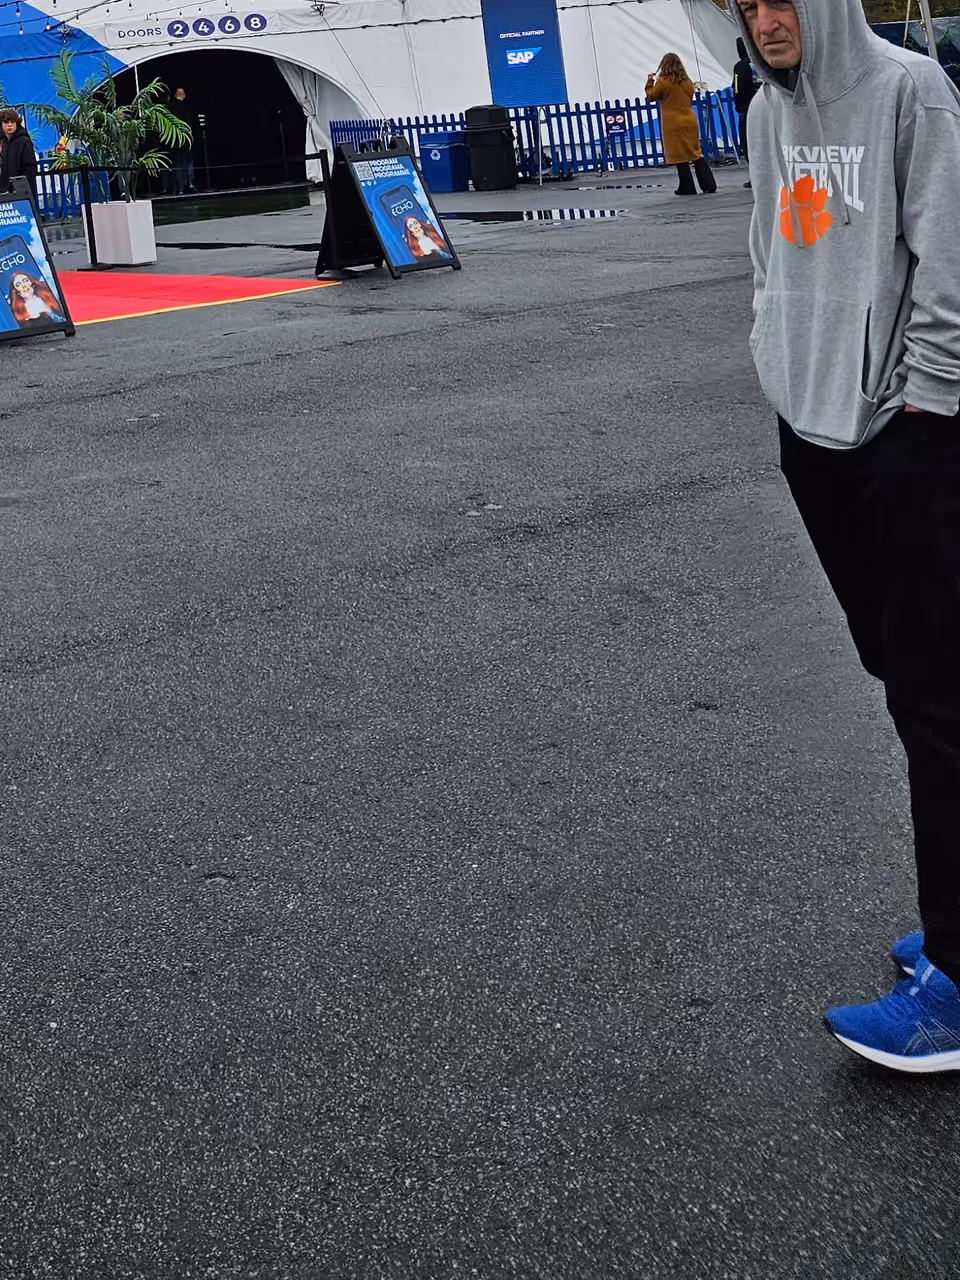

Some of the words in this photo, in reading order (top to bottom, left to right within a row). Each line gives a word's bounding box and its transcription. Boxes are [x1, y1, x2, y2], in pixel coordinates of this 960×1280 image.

[118, 27, 162, 39] DOORS
[173, 23, 185, 36] 2
[198, 21, 210, 33] 4
[224, 19, 235, 32] 6
[250, 17, 261, 29] 8
[522, 29, 545, 37] PARTNER
[506, 50, 534, 65] SAP
[369, 158, 398, 168] PROGRAM
[371, 163, 405, 173] PROGRAMA
[374, 168, 411, 179] PROGRAMME
[391, 200, 413, 217] ECHO
